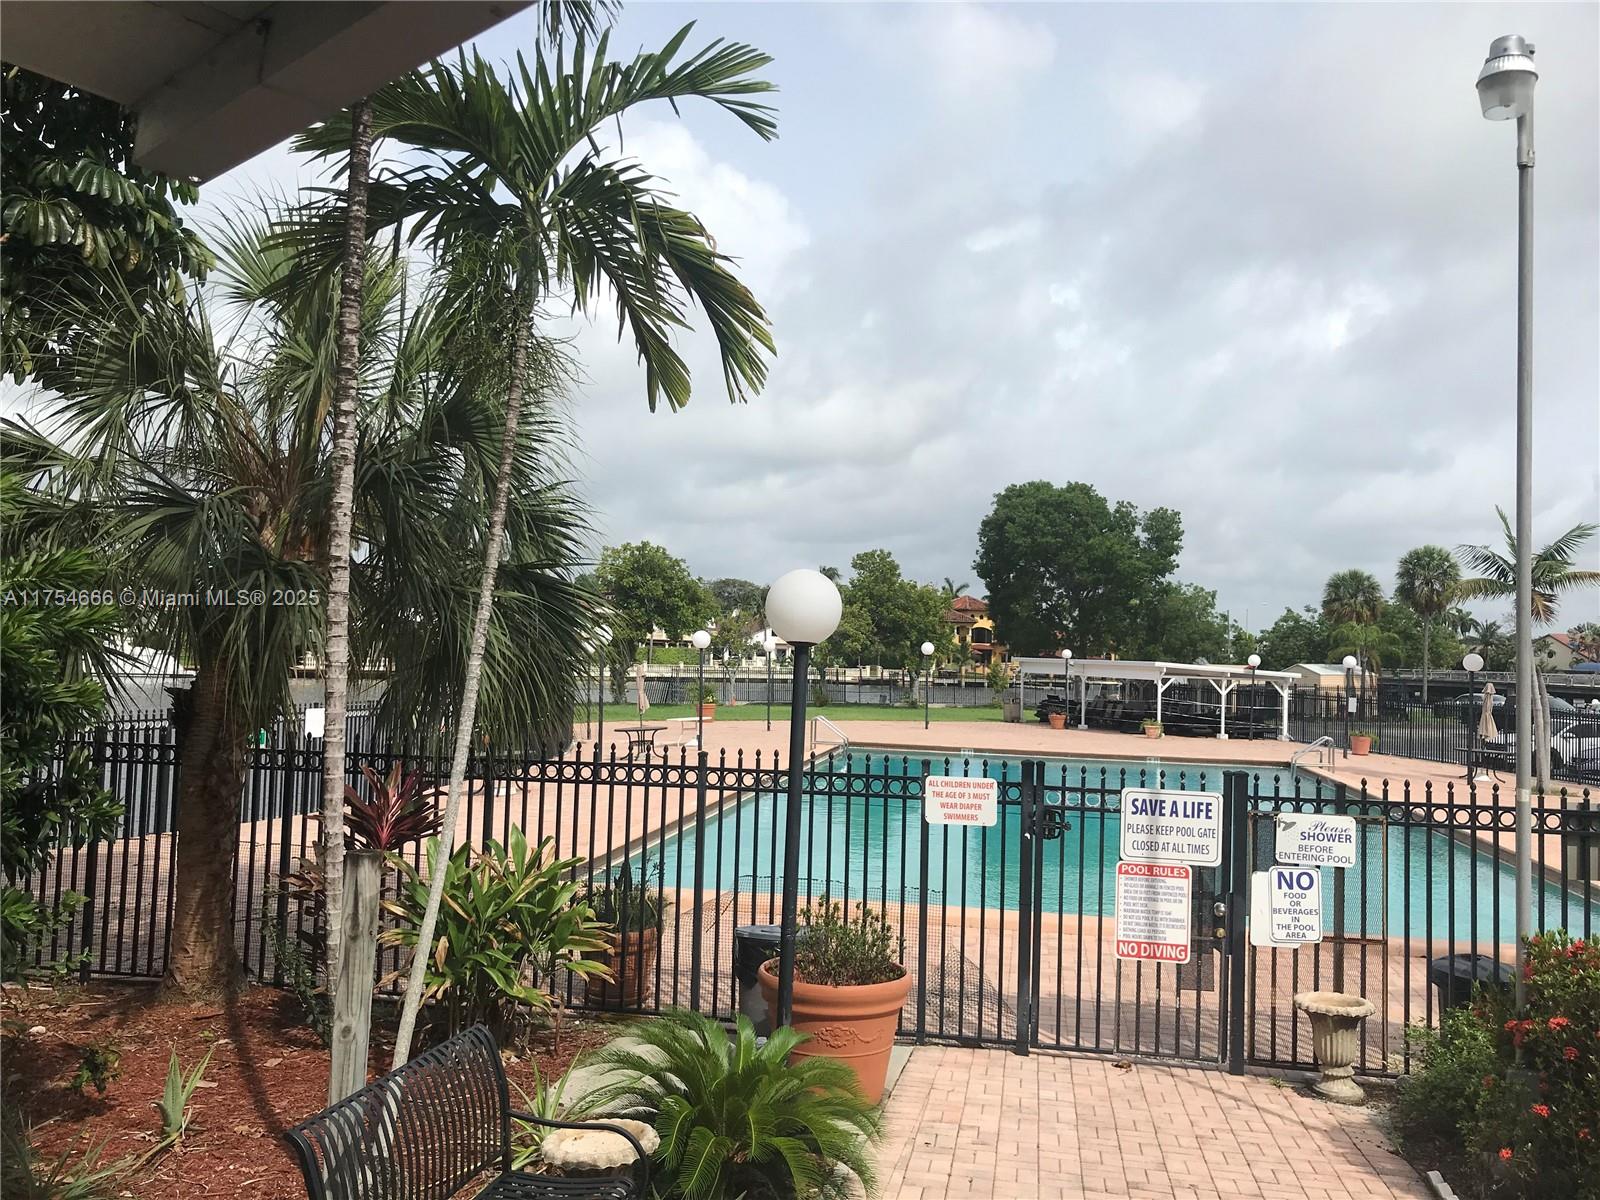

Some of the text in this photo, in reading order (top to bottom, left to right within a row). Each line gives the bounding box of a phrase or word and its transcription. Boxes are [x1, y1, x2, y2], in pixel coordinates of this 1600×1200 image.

[1131, 798, 1212, 819] SAVE A LIFE
[944, 813, 978, 821] SWIMMERS
[1127, 824, 1216, 838] PLEASE KEEP POOL GATE
[1308, 820, 1350, 833] Please
[1300, 832, 1352, 843] SHOWER
[1132, 840, 1210, 855] CLOSED AT ALL TIMES
[1298, 844, 1333, 854] BEFORE
[1279, 852, 1353, 864] ENTERING POOL
[1122, 865, 1186, 877] POOL RULES
[1278, 871, 1314, 890] NO
[1273, 908, 1319, 916] BEVERAGES
[1119, 942, 1186, 959] NO DIVING
